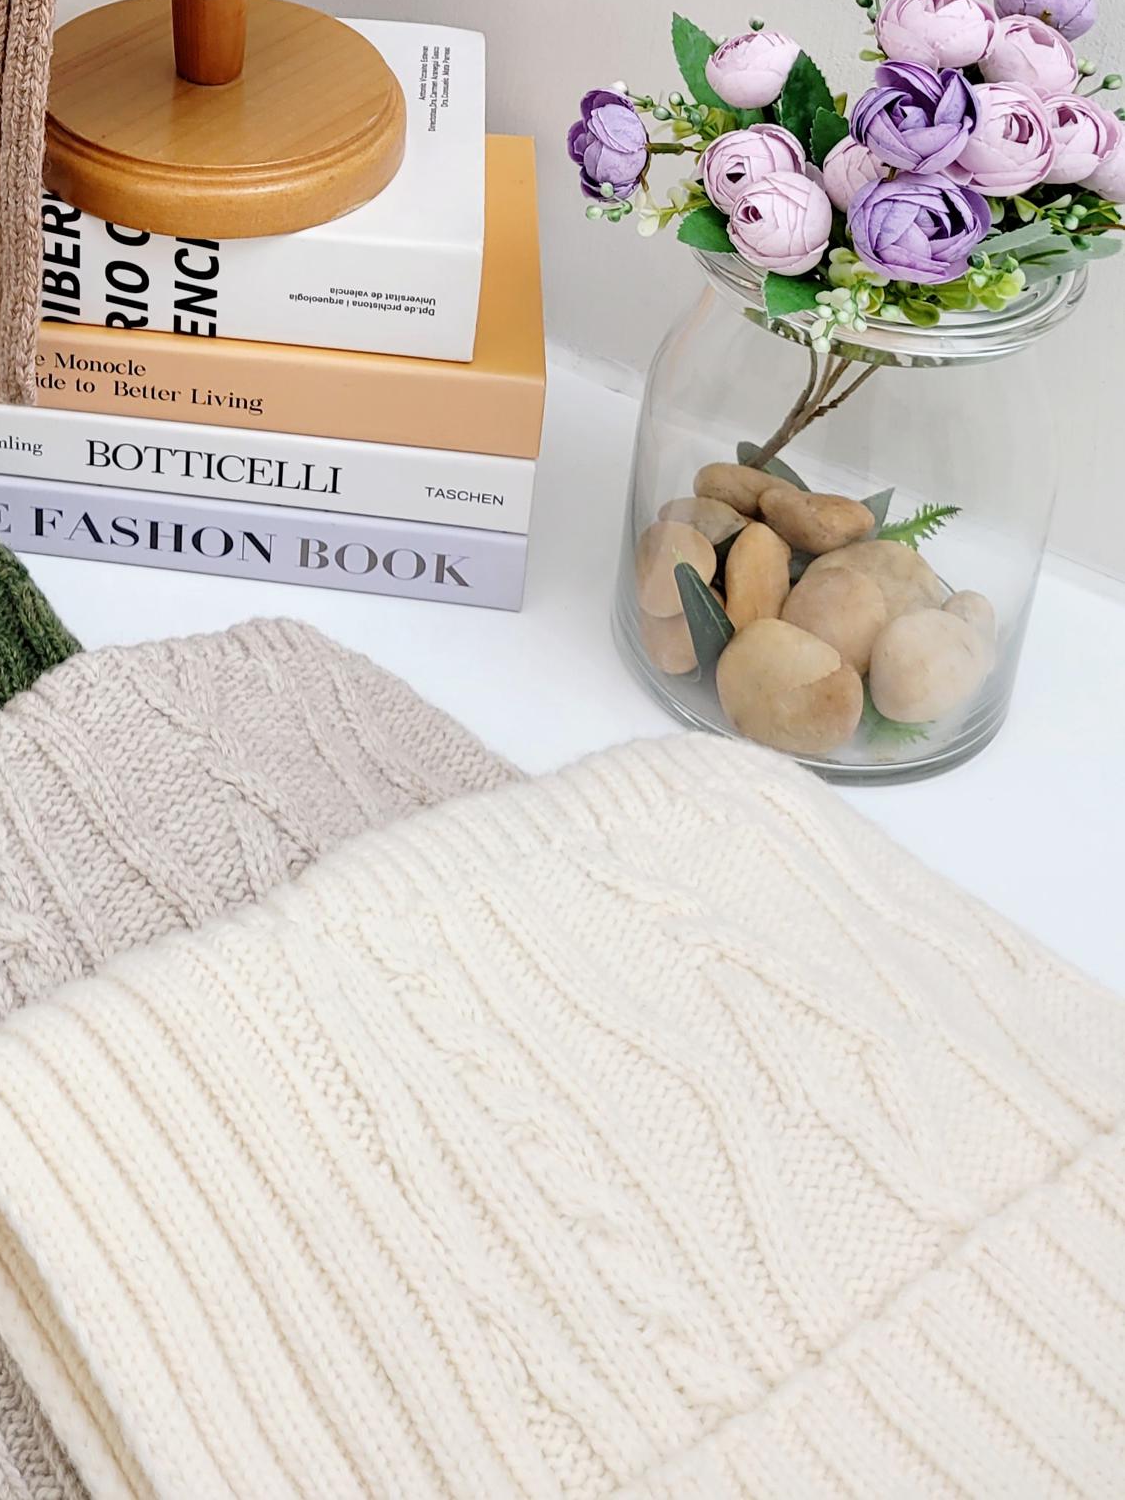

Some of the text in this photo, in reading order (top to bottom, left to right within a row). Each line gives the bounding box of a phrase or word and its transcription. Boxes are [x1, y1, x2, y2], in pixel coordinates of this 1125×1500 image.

[329, 287, 436, 306] Universitat de valencia
[54, 352, 146, 377] Monocle
[35, 372, 264, 416] ide to Better Living
[86, 439, 343, 495] BOTTICELLI
[424, 486, 505, 506] TASCHEN
[29, 506, 277, 564] FASHON
[296, 536, 474, 589] BOOK
